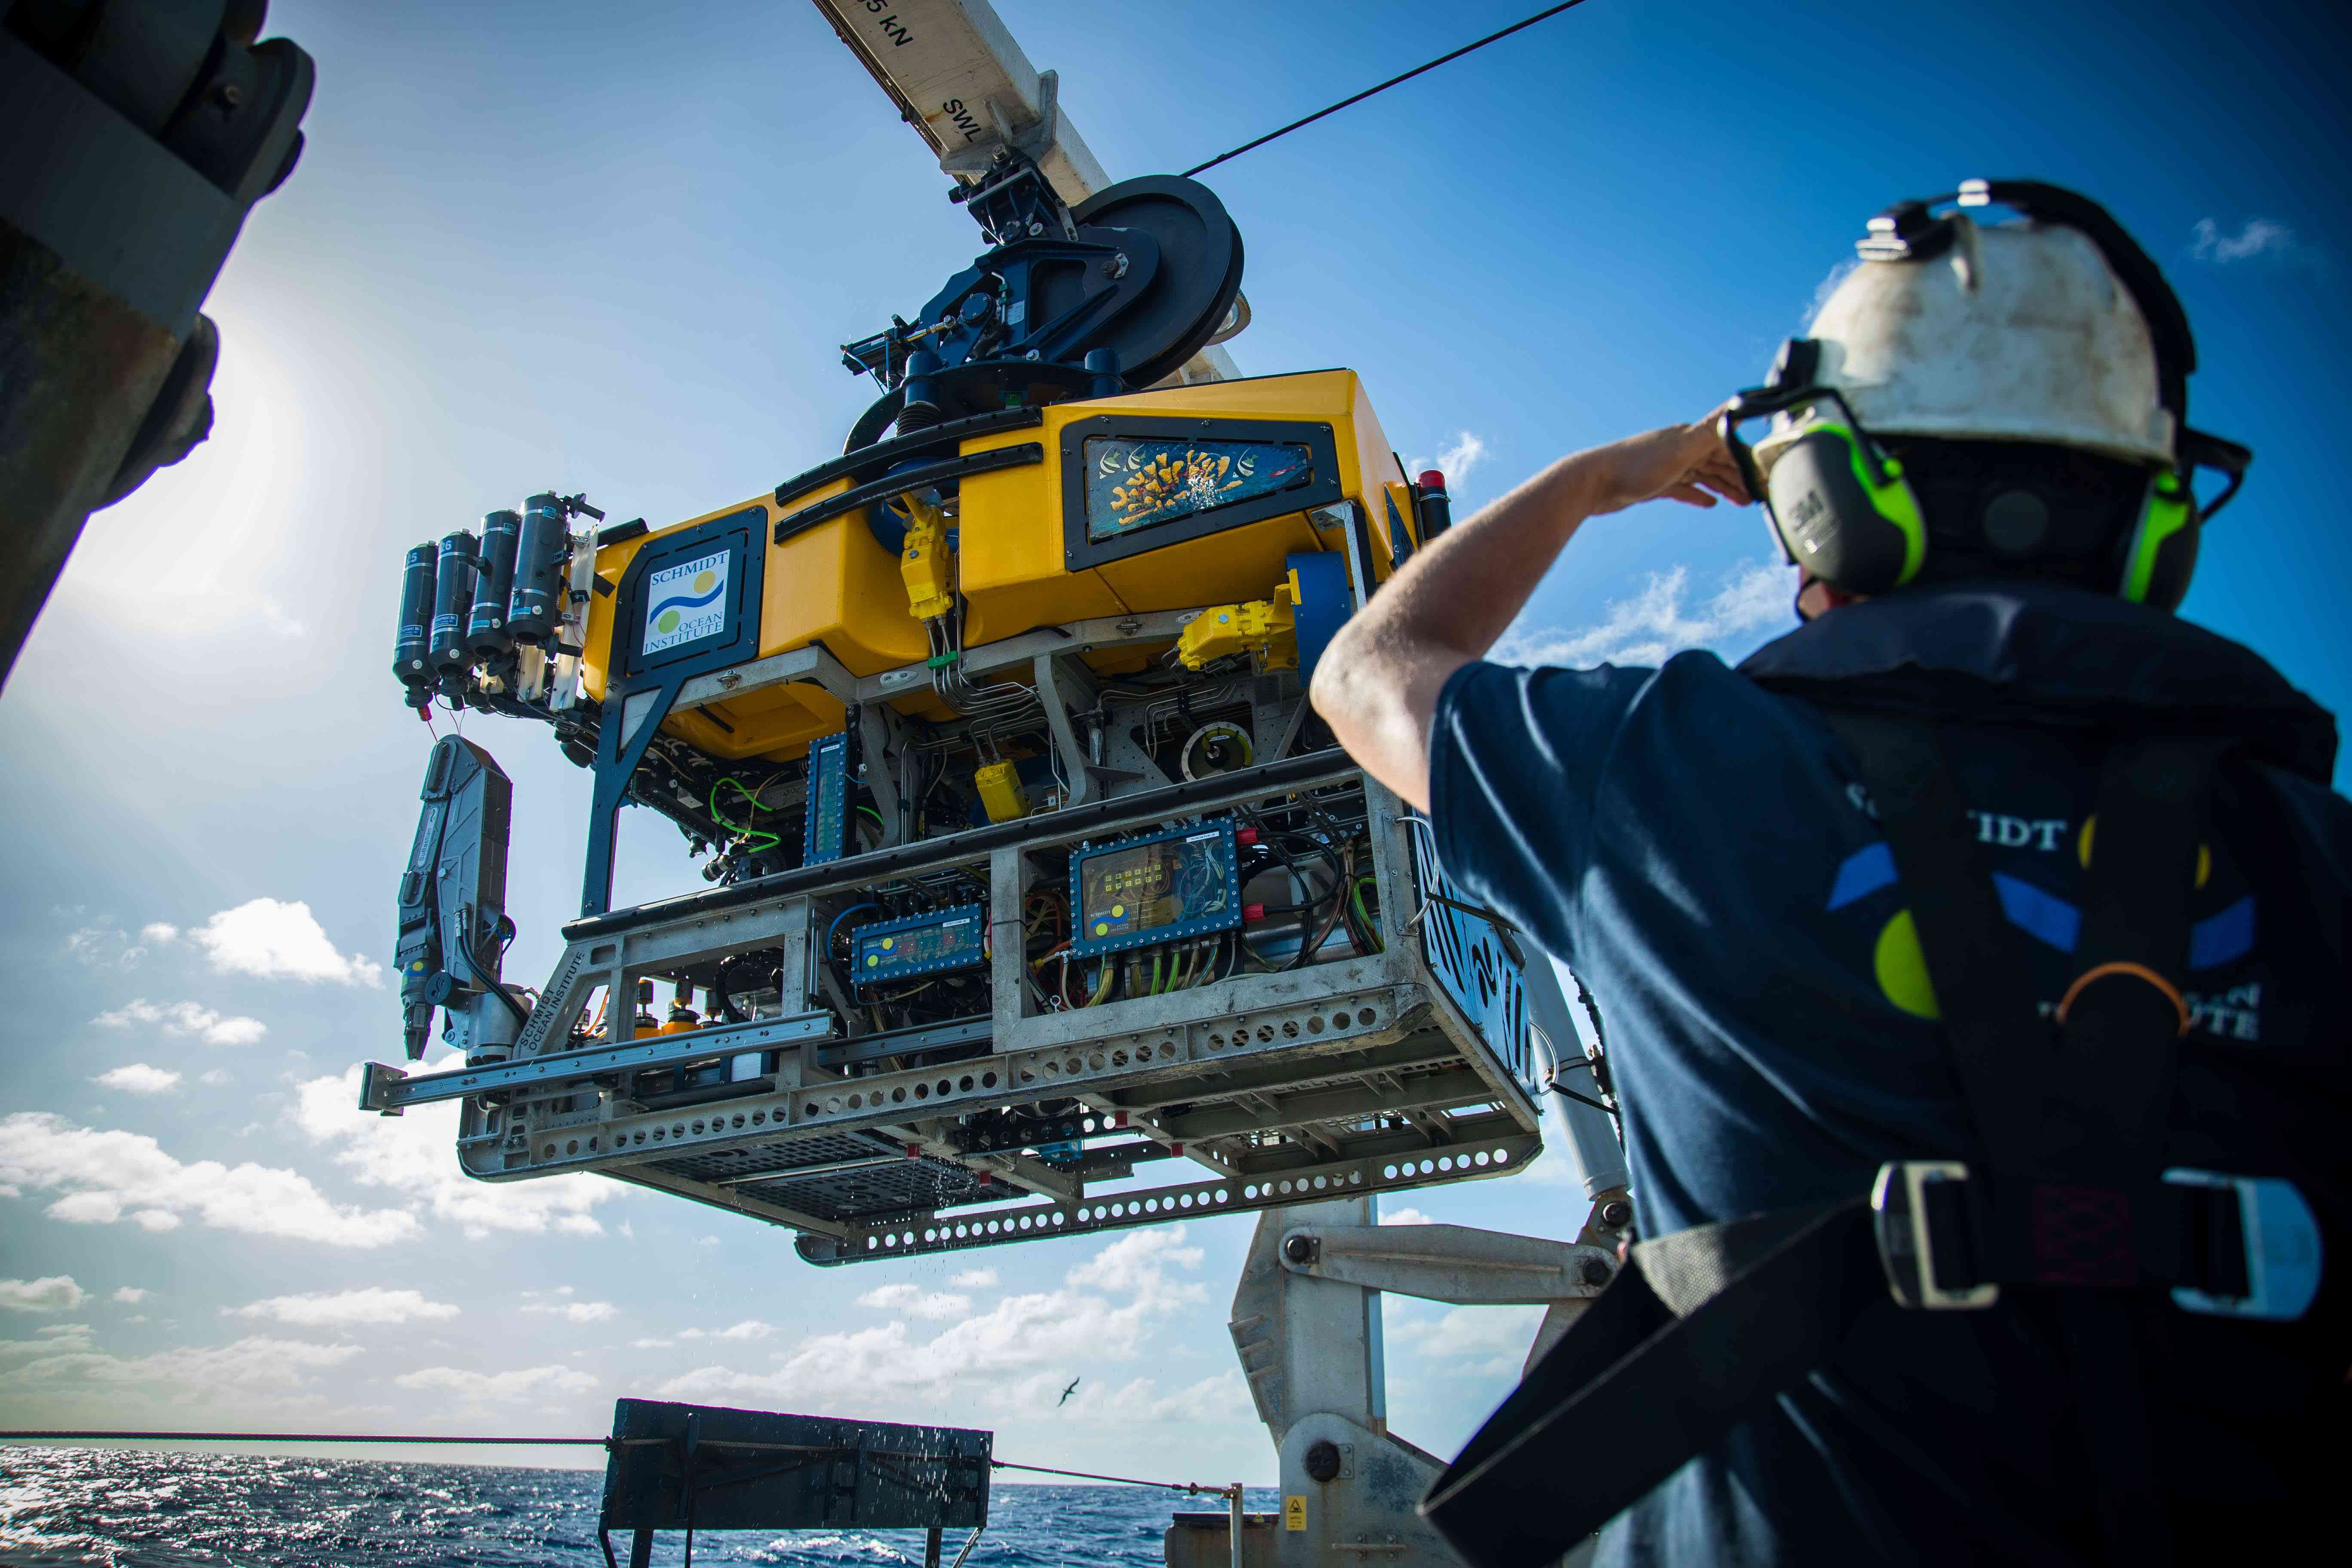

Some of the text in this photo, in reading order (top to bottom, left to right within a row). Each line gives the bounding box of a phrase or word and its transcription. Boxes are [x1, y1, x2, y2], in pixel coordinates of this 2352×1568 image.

[879, 15, 914, 47] kN
[943, 99, 982, 143] SWL
[441, 540, 452, 551] 26
[652, 552, 728, 585] SCHMIDT
[514, 598, 519, 606] 4
[645, 621, 722, 653] INSTITUTE
[679, 611, 723, 632] OCEAN
[434, 636, 439, 646] 2
[521, 987, 554, 1046] SCHMIDT
[529, 951, 585, 1050] OCEAN INSTITUTE
